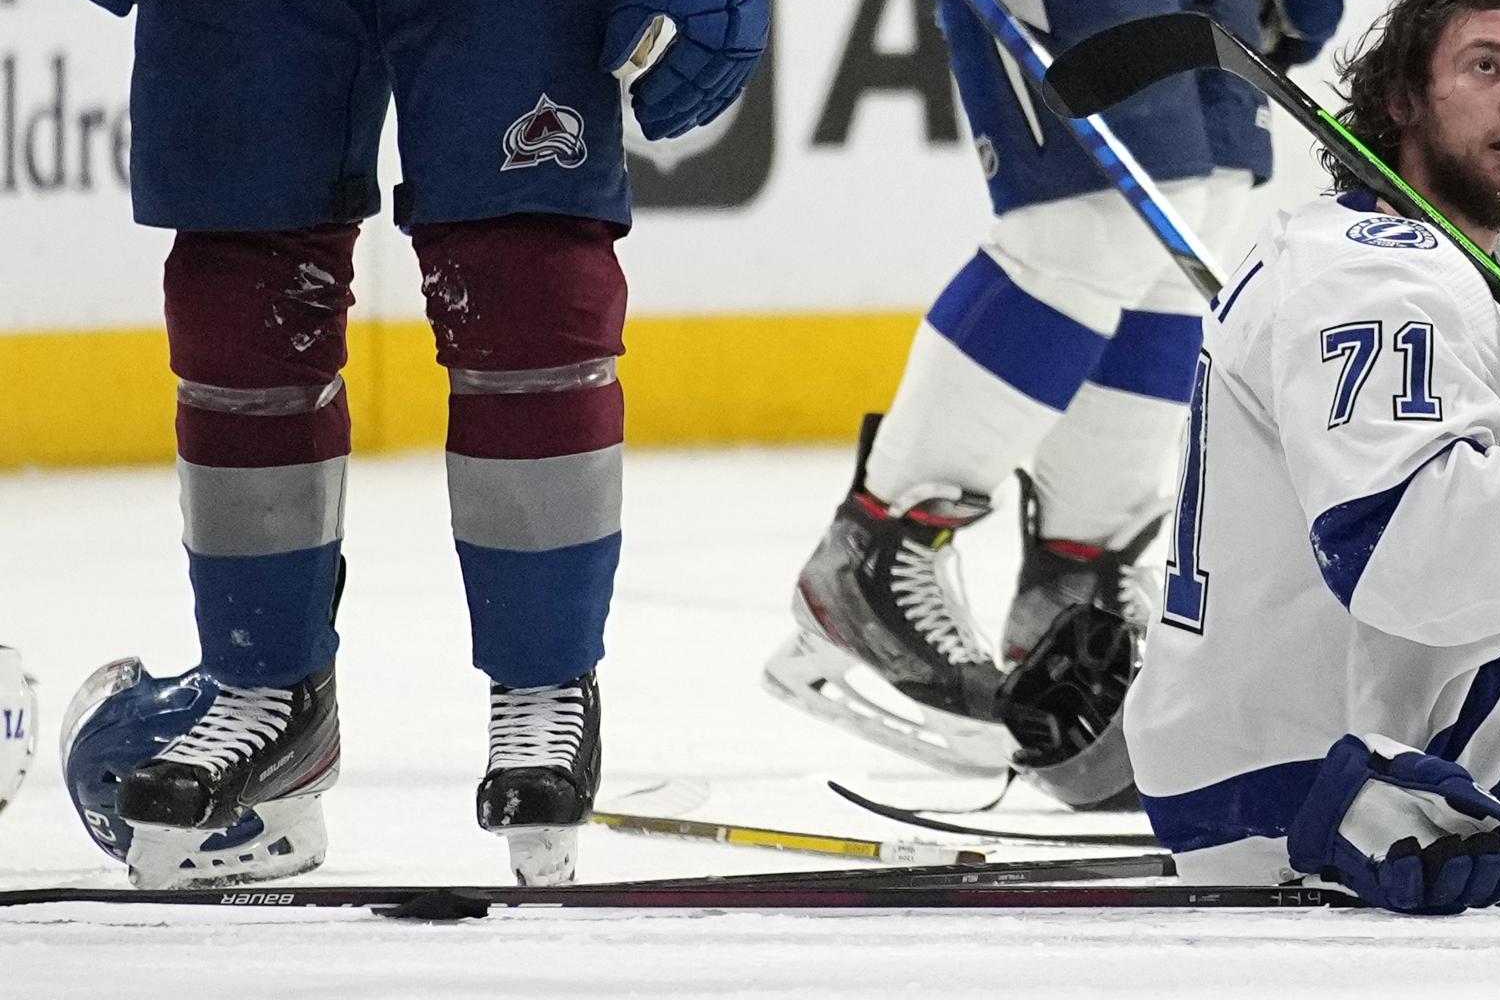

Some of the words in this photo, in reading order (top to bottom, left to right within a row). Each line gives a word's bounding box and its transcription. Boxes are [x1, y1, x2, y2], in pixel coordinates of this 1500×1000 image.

[1320, 319, 1444, 431] 71
[3, 708, 25, 740] 71
[259, 750, 295, 782] BAUER
[219, 891, 296, 907] BAUER
